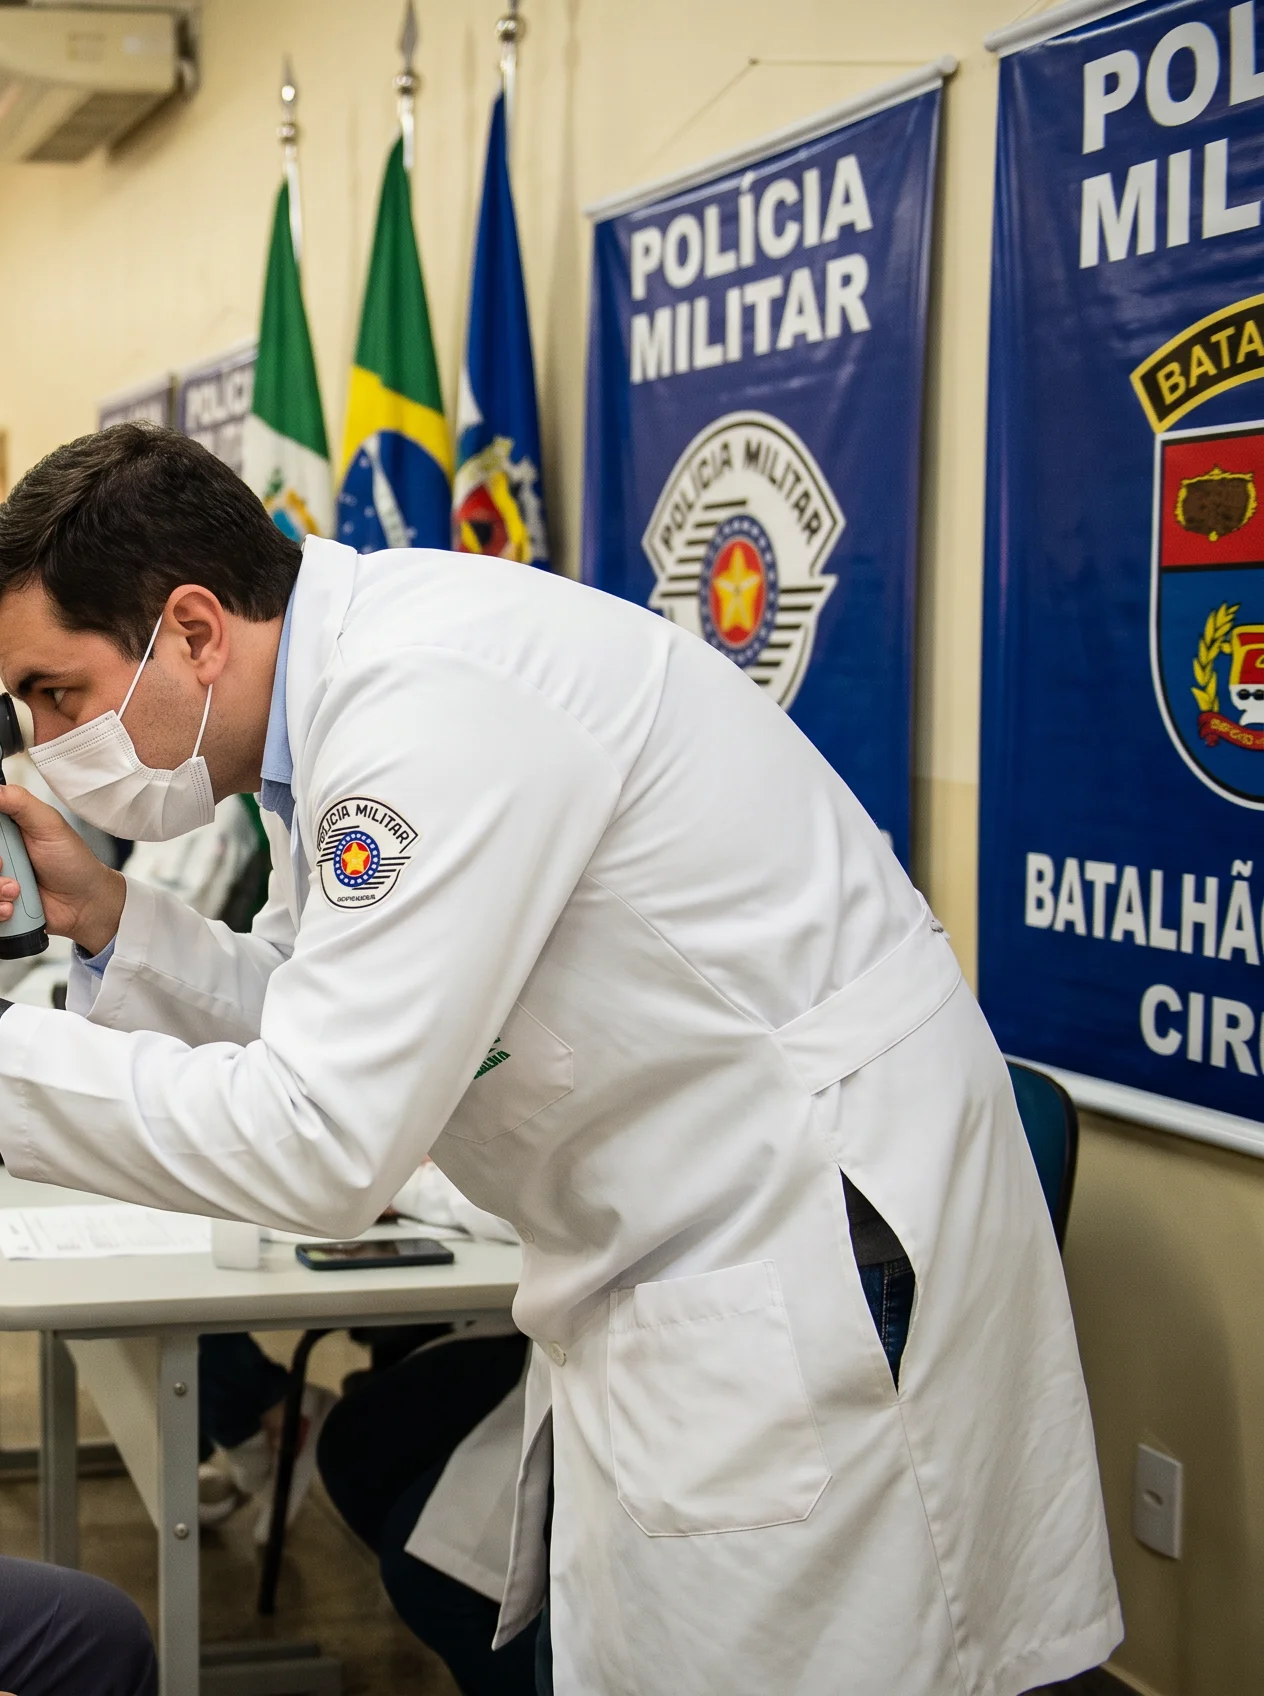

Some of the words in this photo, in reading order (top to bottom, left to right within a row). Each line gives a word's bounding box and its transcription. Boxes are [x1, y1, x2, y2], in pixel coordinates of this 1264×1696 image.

[1082, 0, 1264, 155] POL
[631, 154, 874, 302] POLÍCIA
[1079, 137, 1262, 270] MIL
[630, 253, 872, 386] MILITAR
[1155, 319, 1264, 406] BATA
[742, 437, 824, 547] MILITAR
[355, 803, 410, 845] MILITAR
[1025, 851, 1264, 966] BATALHÃ
[1140, 983, 1264, 1077] CIR
